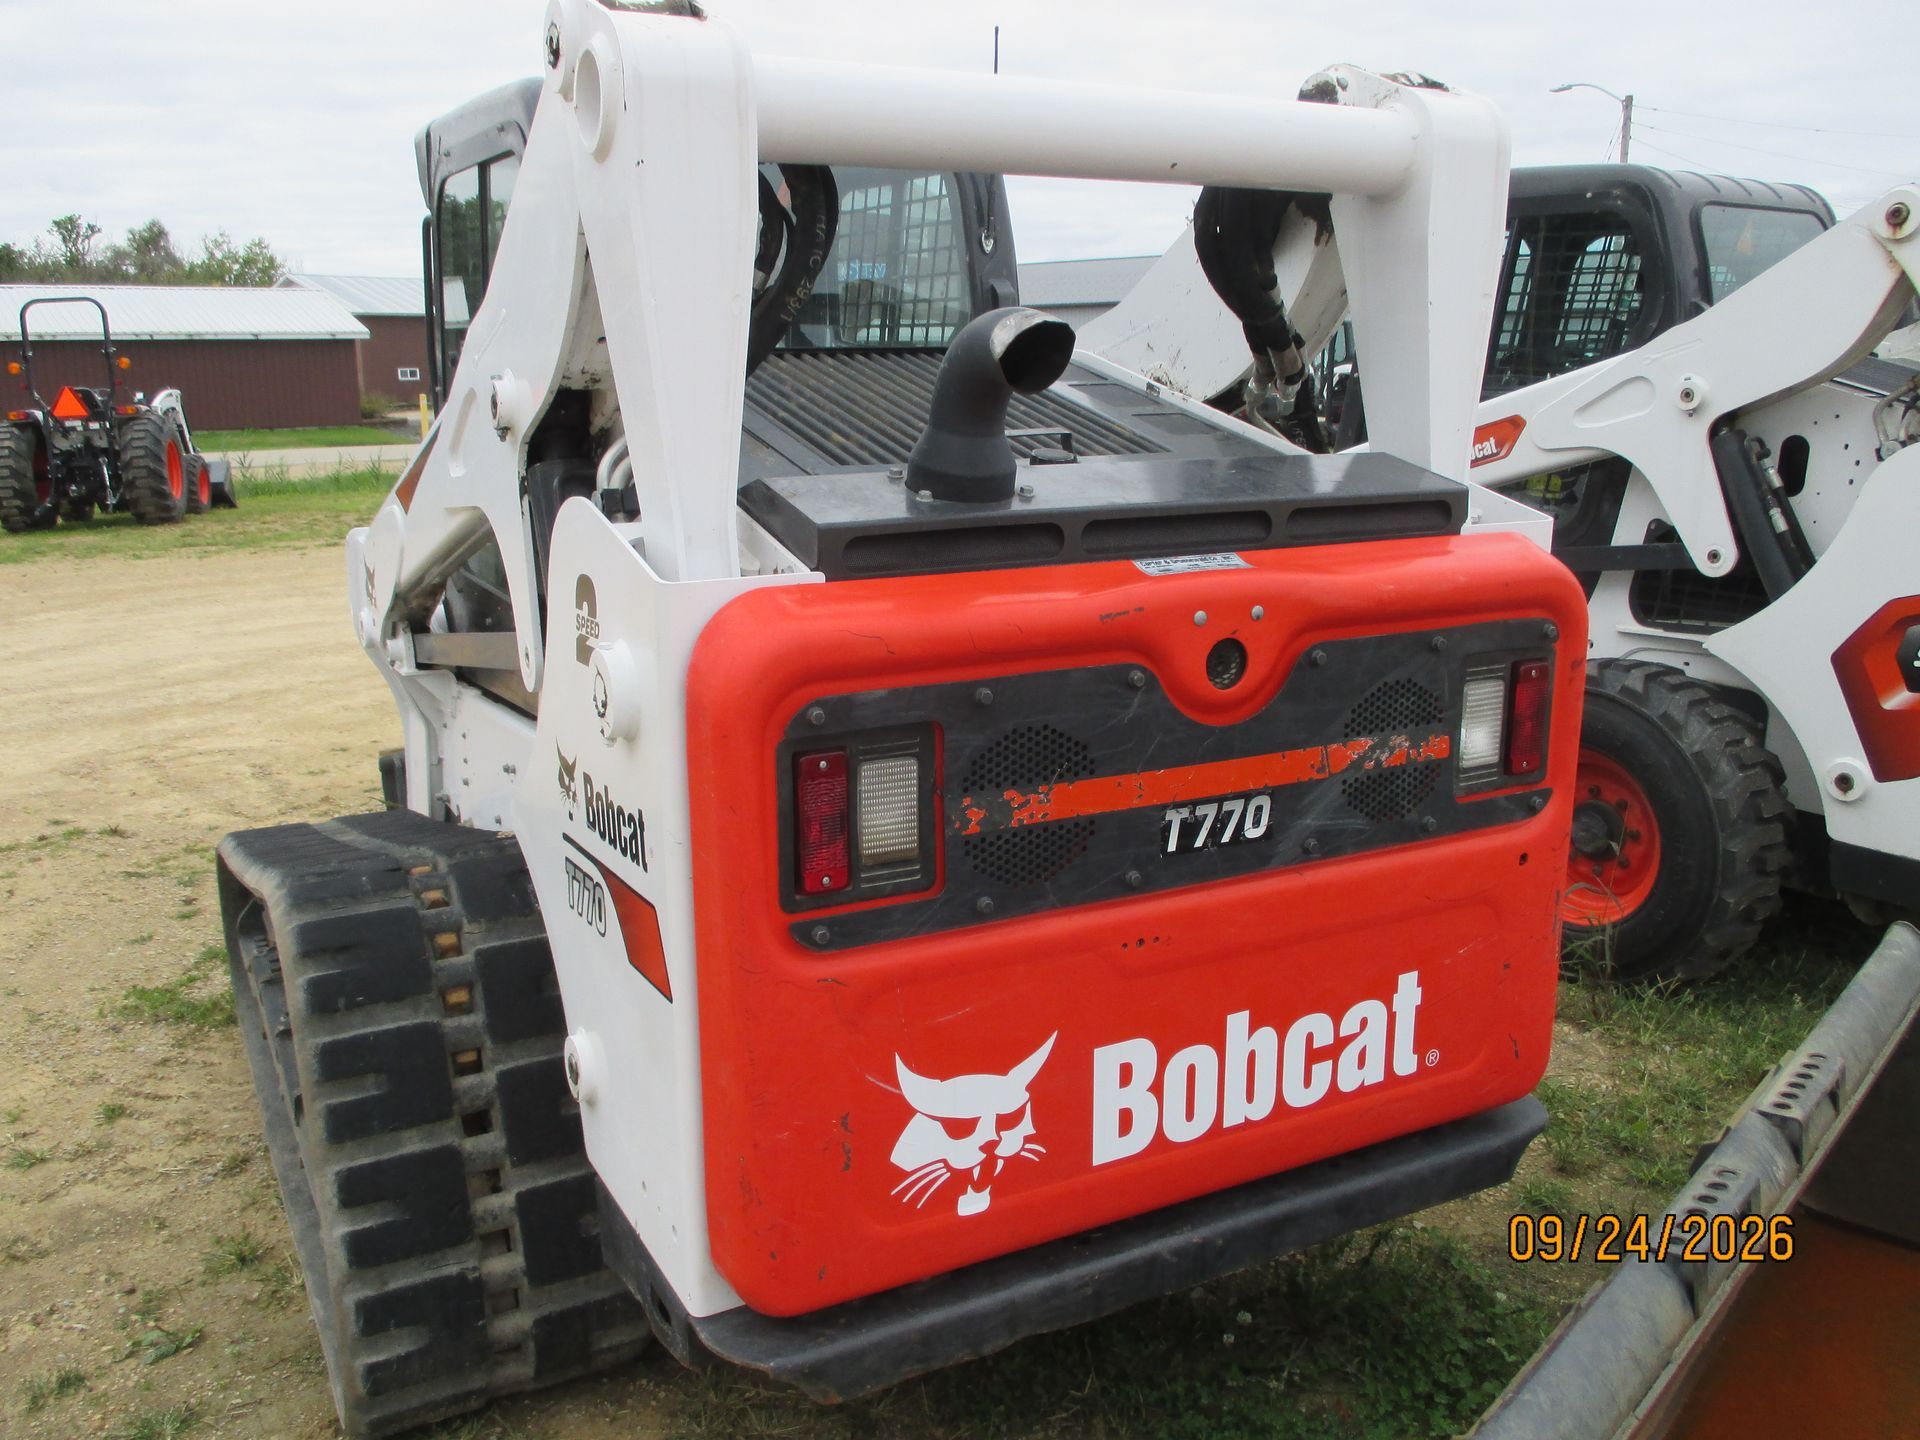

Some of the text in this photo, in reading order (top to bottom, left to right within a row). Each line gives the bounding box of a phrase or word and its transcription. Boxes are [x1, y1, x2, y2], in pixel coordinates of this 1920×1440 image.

[575, 573, 598, 667] 2
[575, 613, 600, 639] SPEED
[583, 771, 648, 873] Bobcat
[1165, 794, 1271, 852] T770
[565, 856, 607, 938] T770
[1093, 970, 1422, 1166] Bobcat
